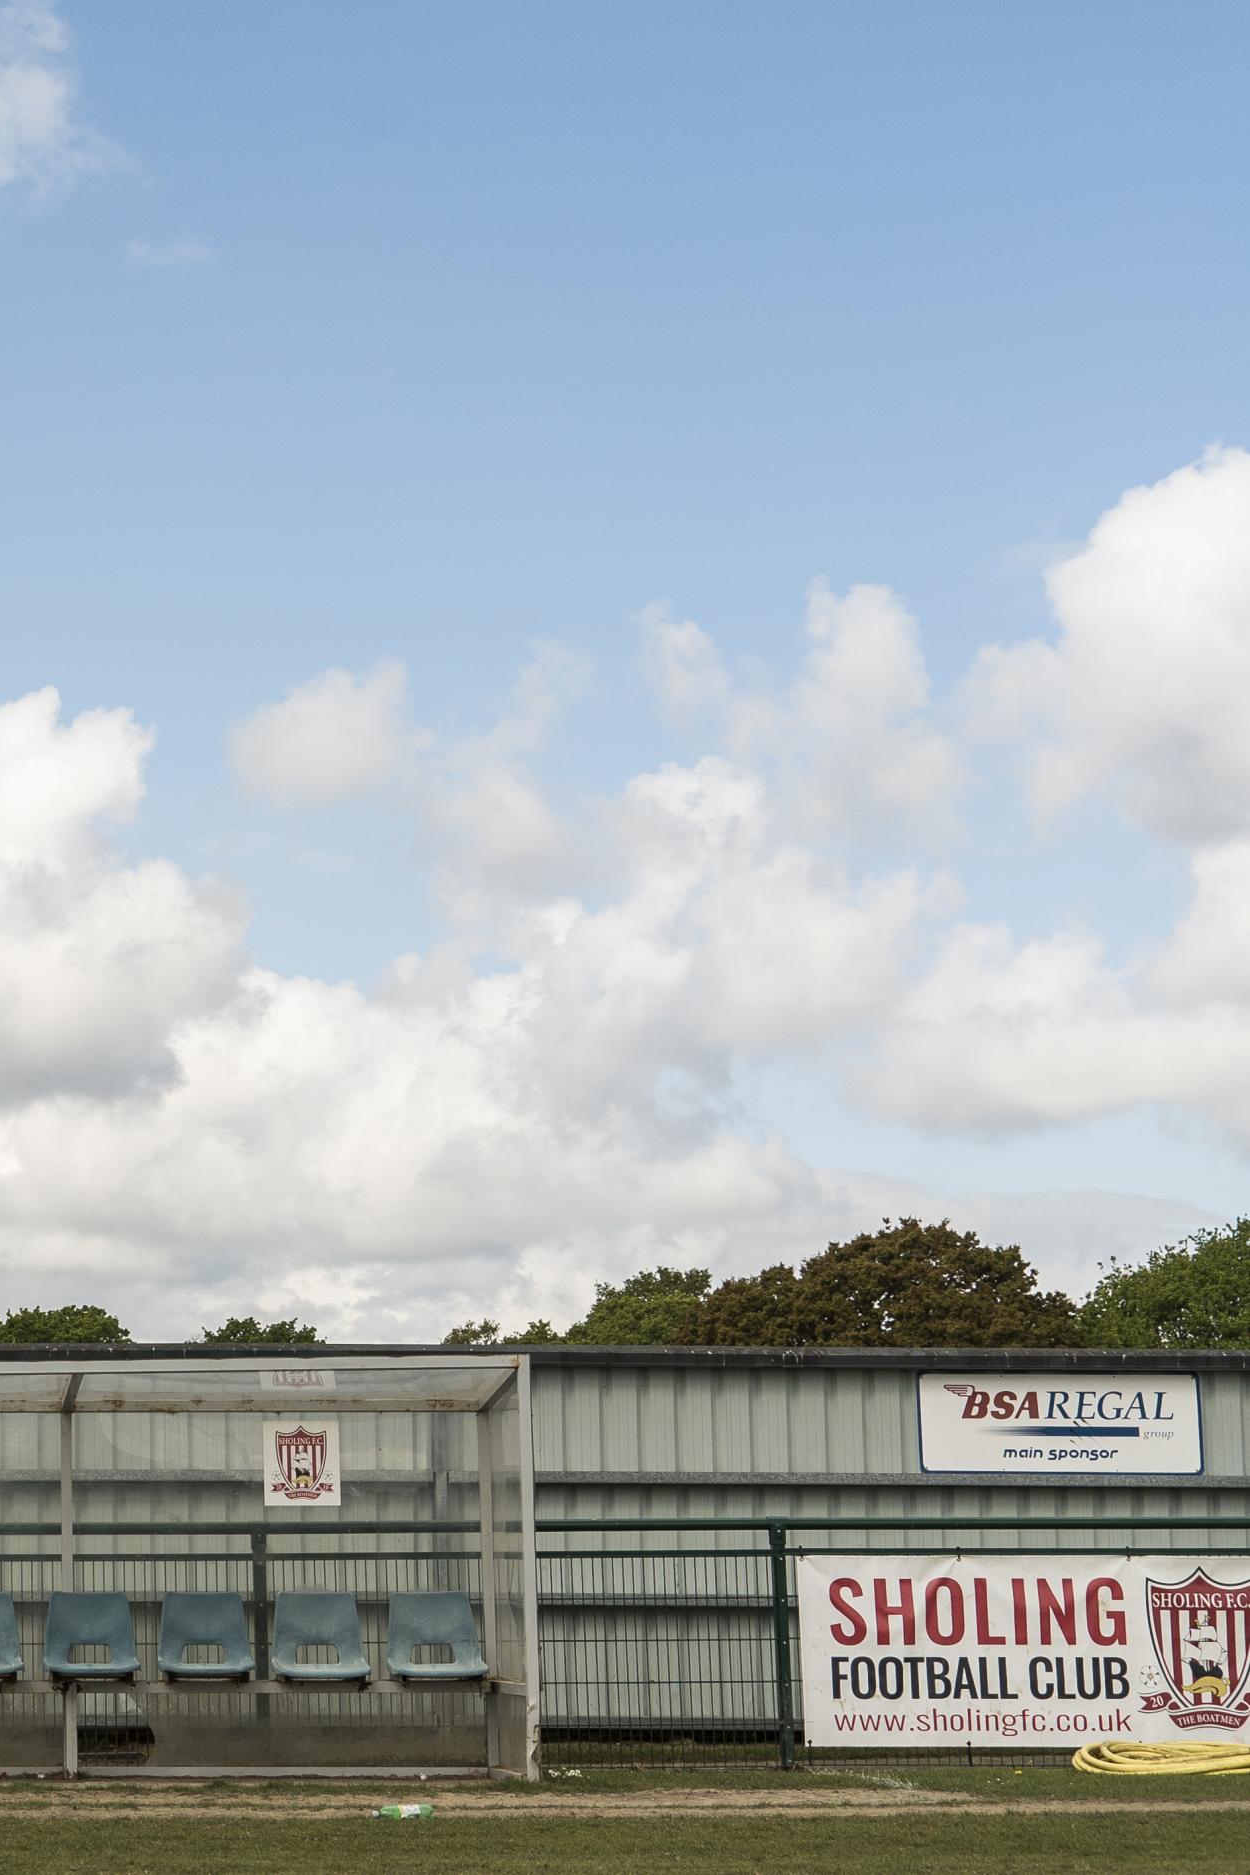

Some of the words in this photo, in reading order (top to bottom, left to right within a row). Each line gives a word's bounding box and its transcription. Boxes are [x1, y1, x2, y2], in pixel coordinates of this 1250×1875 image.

[279, 1437, 311, 1446] SHOLING
[312, 1437, 324, 1445] F.C.
[1143, 1430, 1174, 1440] group
[1003, 1446, 1043, 1459] main
[1048, 1448, 1118, 1461] sponsor
[1152, 1592, 1223, 1609] SHOLING
[829, 1577, 1127, 1646] SHOLING
[831, 1656, 1018, 1700] FOOTBALL
[1029, 1656, 1130, 1700] CLUB
[1150, 1695, 1164, 1708] 20
[834, 1708, 1132, 1737] www.sholingfc.co.uk
[1177, 1715, 1196, 1727] THE
[1197, 1714, 1241, 1727] BOATMEN
